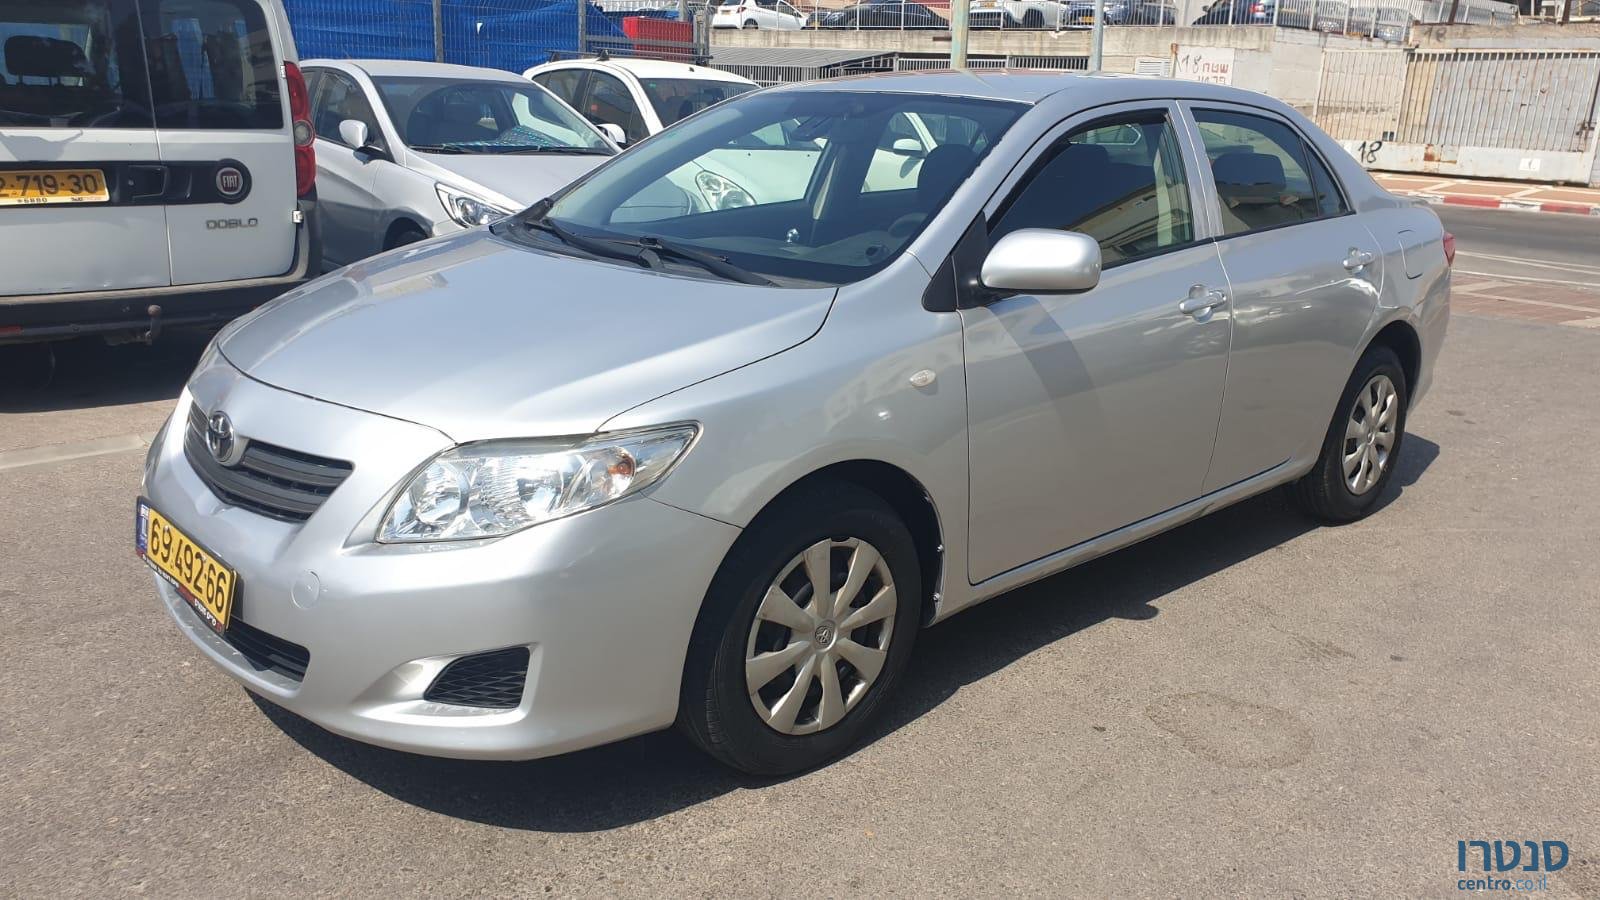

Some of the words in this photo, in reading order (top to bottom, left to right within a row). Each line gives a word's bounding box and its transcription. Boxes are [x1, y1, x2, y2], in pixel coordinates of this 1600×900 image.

[1357, 140, 1383, 163] 18
[222, 175, 238, 188] FIAT
[206, 218, 258, 230] DOBLO
